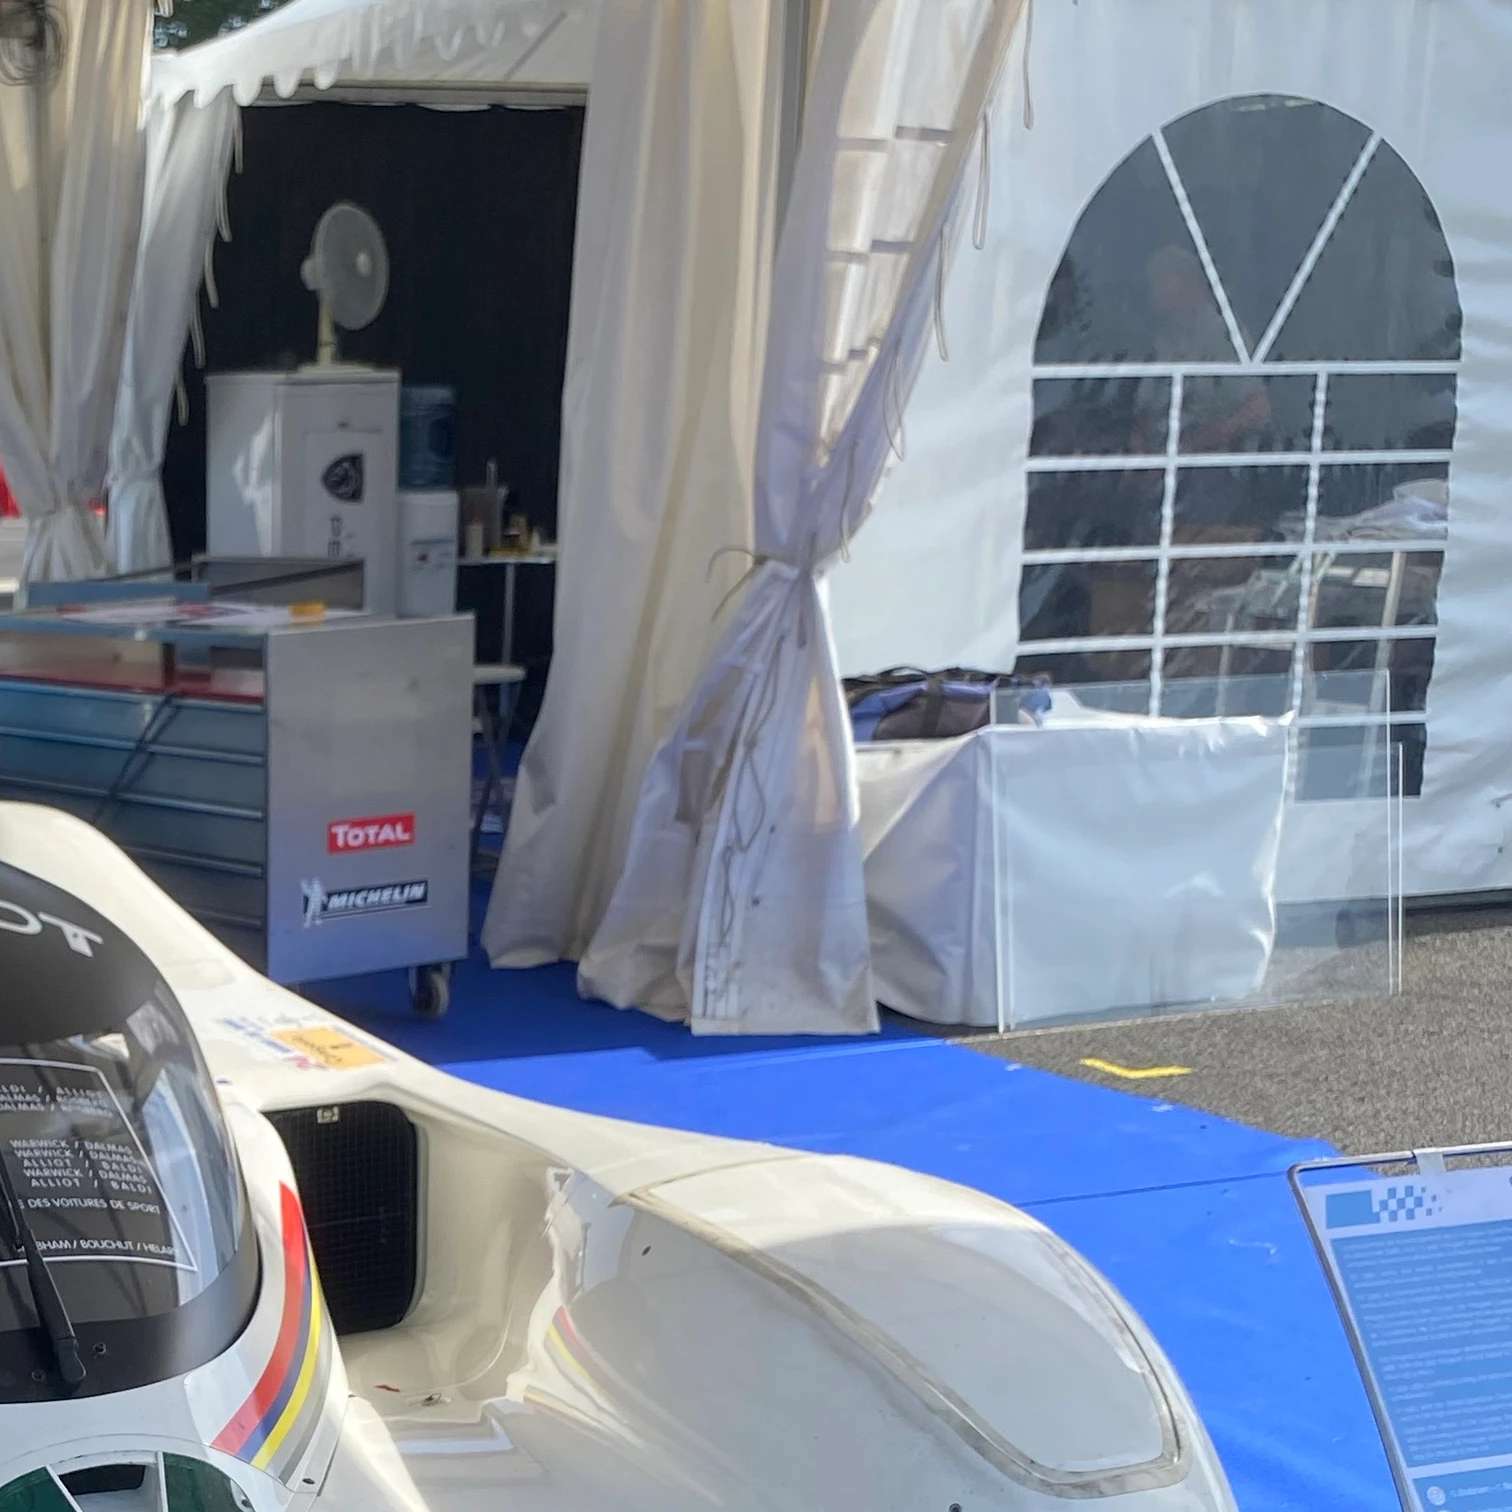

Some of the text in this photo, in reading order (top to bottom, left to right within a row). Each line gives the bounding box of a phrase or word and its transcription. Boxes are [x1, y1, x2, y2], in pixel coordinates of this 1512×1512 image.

[331, 821, 410, 848] TOTAL
[327, 882, 426, 911] MICHELIN
[9, 1139, 69, 1149] WARWICK
[14, 1149, 74, 1159] WARWICK
[23, 1158, 73, 1168] ALLIOT
[23, 1168, 84, 1178] WARWICK
[31, 1178, 81, 1188] ALLIOT
[27, 1198, 51, 1209] DES
[53, 1197, 108, 1209] VOITURES
[109, 1198, 126, 1210] DE
[79, 1239, 134, 1251] BOUCHUT
